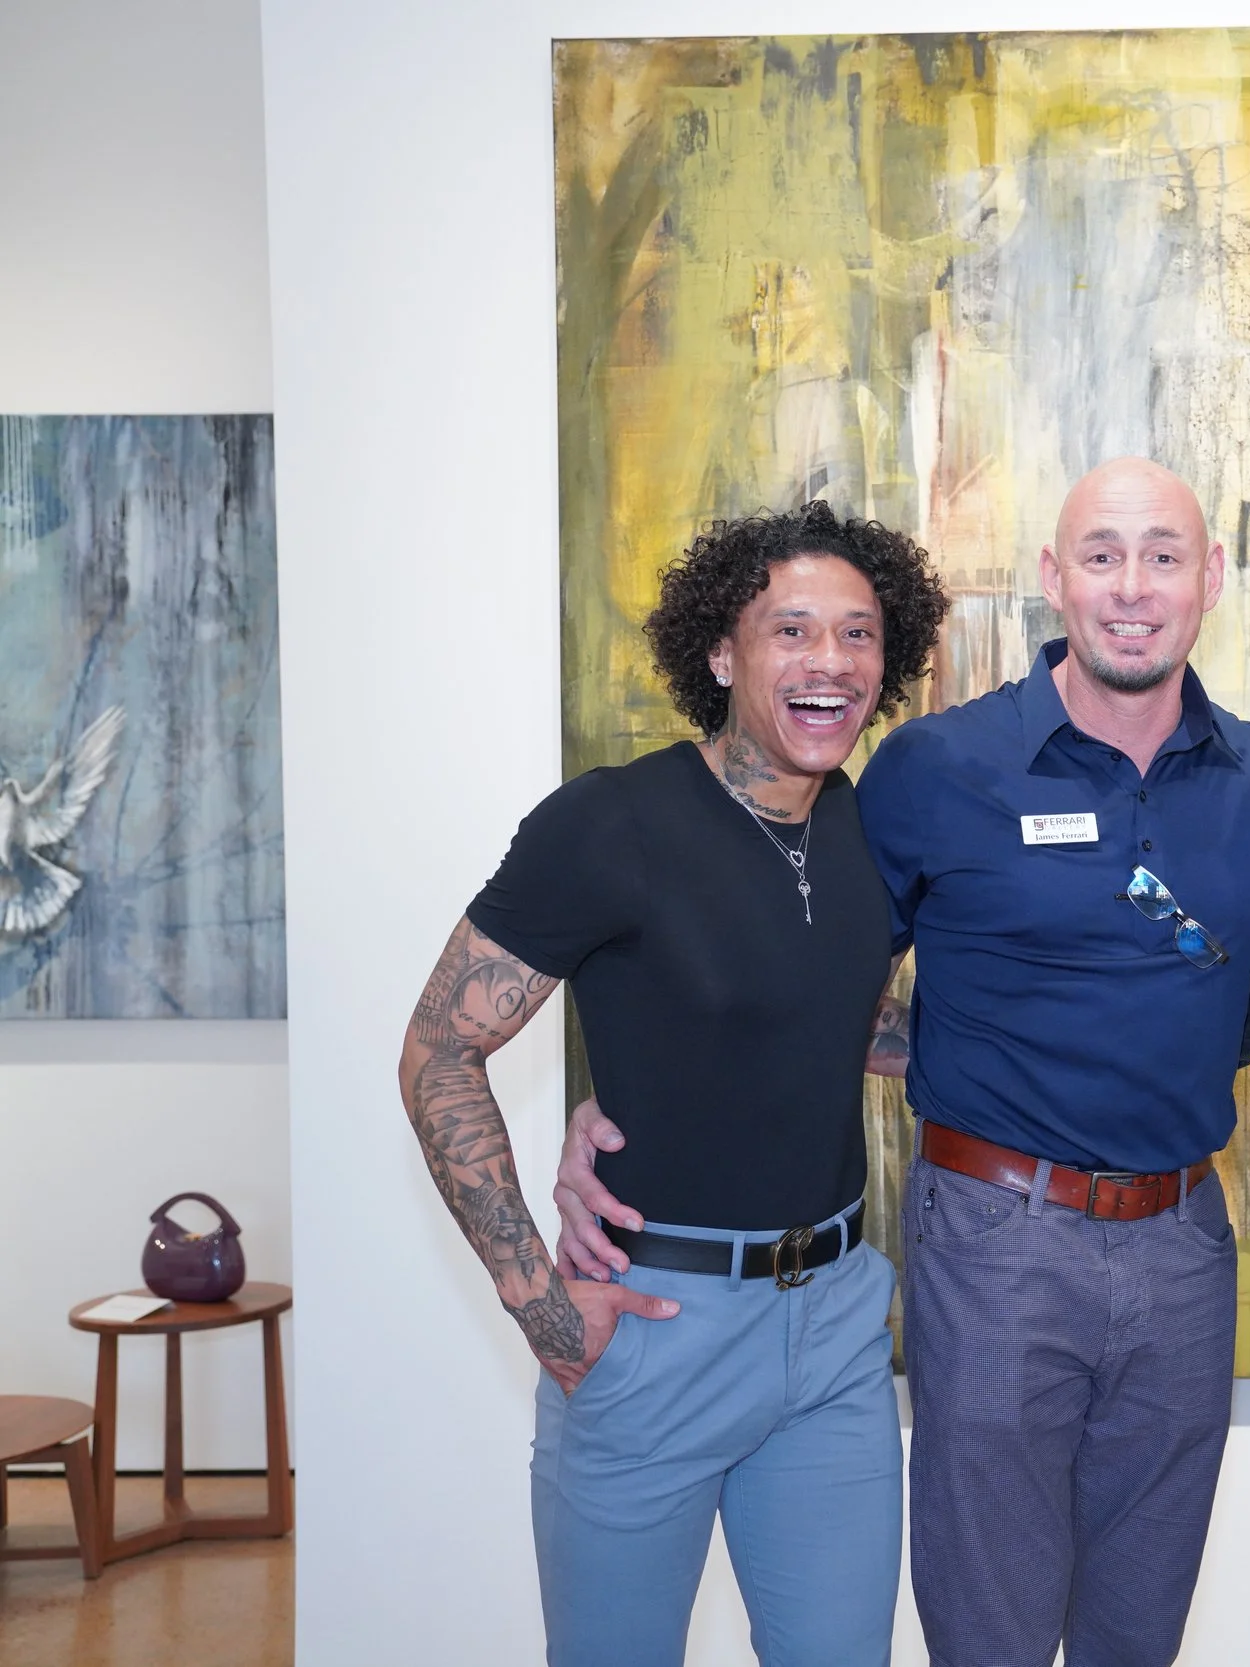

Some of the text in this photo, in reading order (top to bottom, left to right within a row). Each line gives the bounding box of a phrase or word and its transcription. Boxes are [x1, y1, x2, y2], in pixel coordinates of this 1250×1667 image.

[1043, 816, 1086, 826] FERRARI
[1035, 831, 1088, 841] James Ferrari
